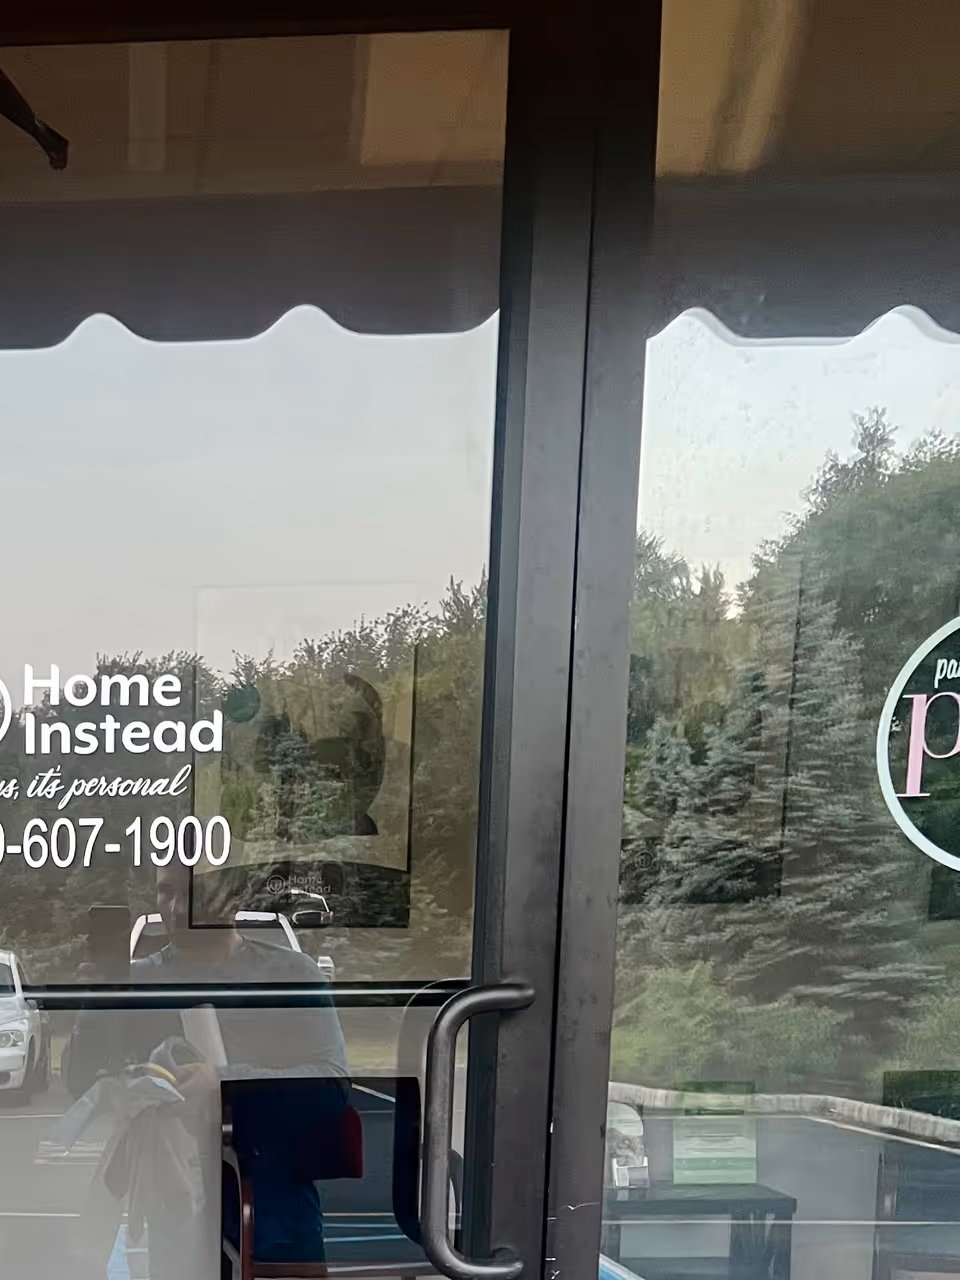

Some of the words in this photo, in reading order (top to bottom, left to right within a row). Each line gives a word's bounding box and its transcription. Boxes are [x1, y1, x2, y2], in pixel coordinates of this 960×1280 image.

[23, 663, 182, 707] Home
[24, 709, 225, 755] Instead
[26, 764, 65, 799] it's
[57, 764, 193, 811] personal
